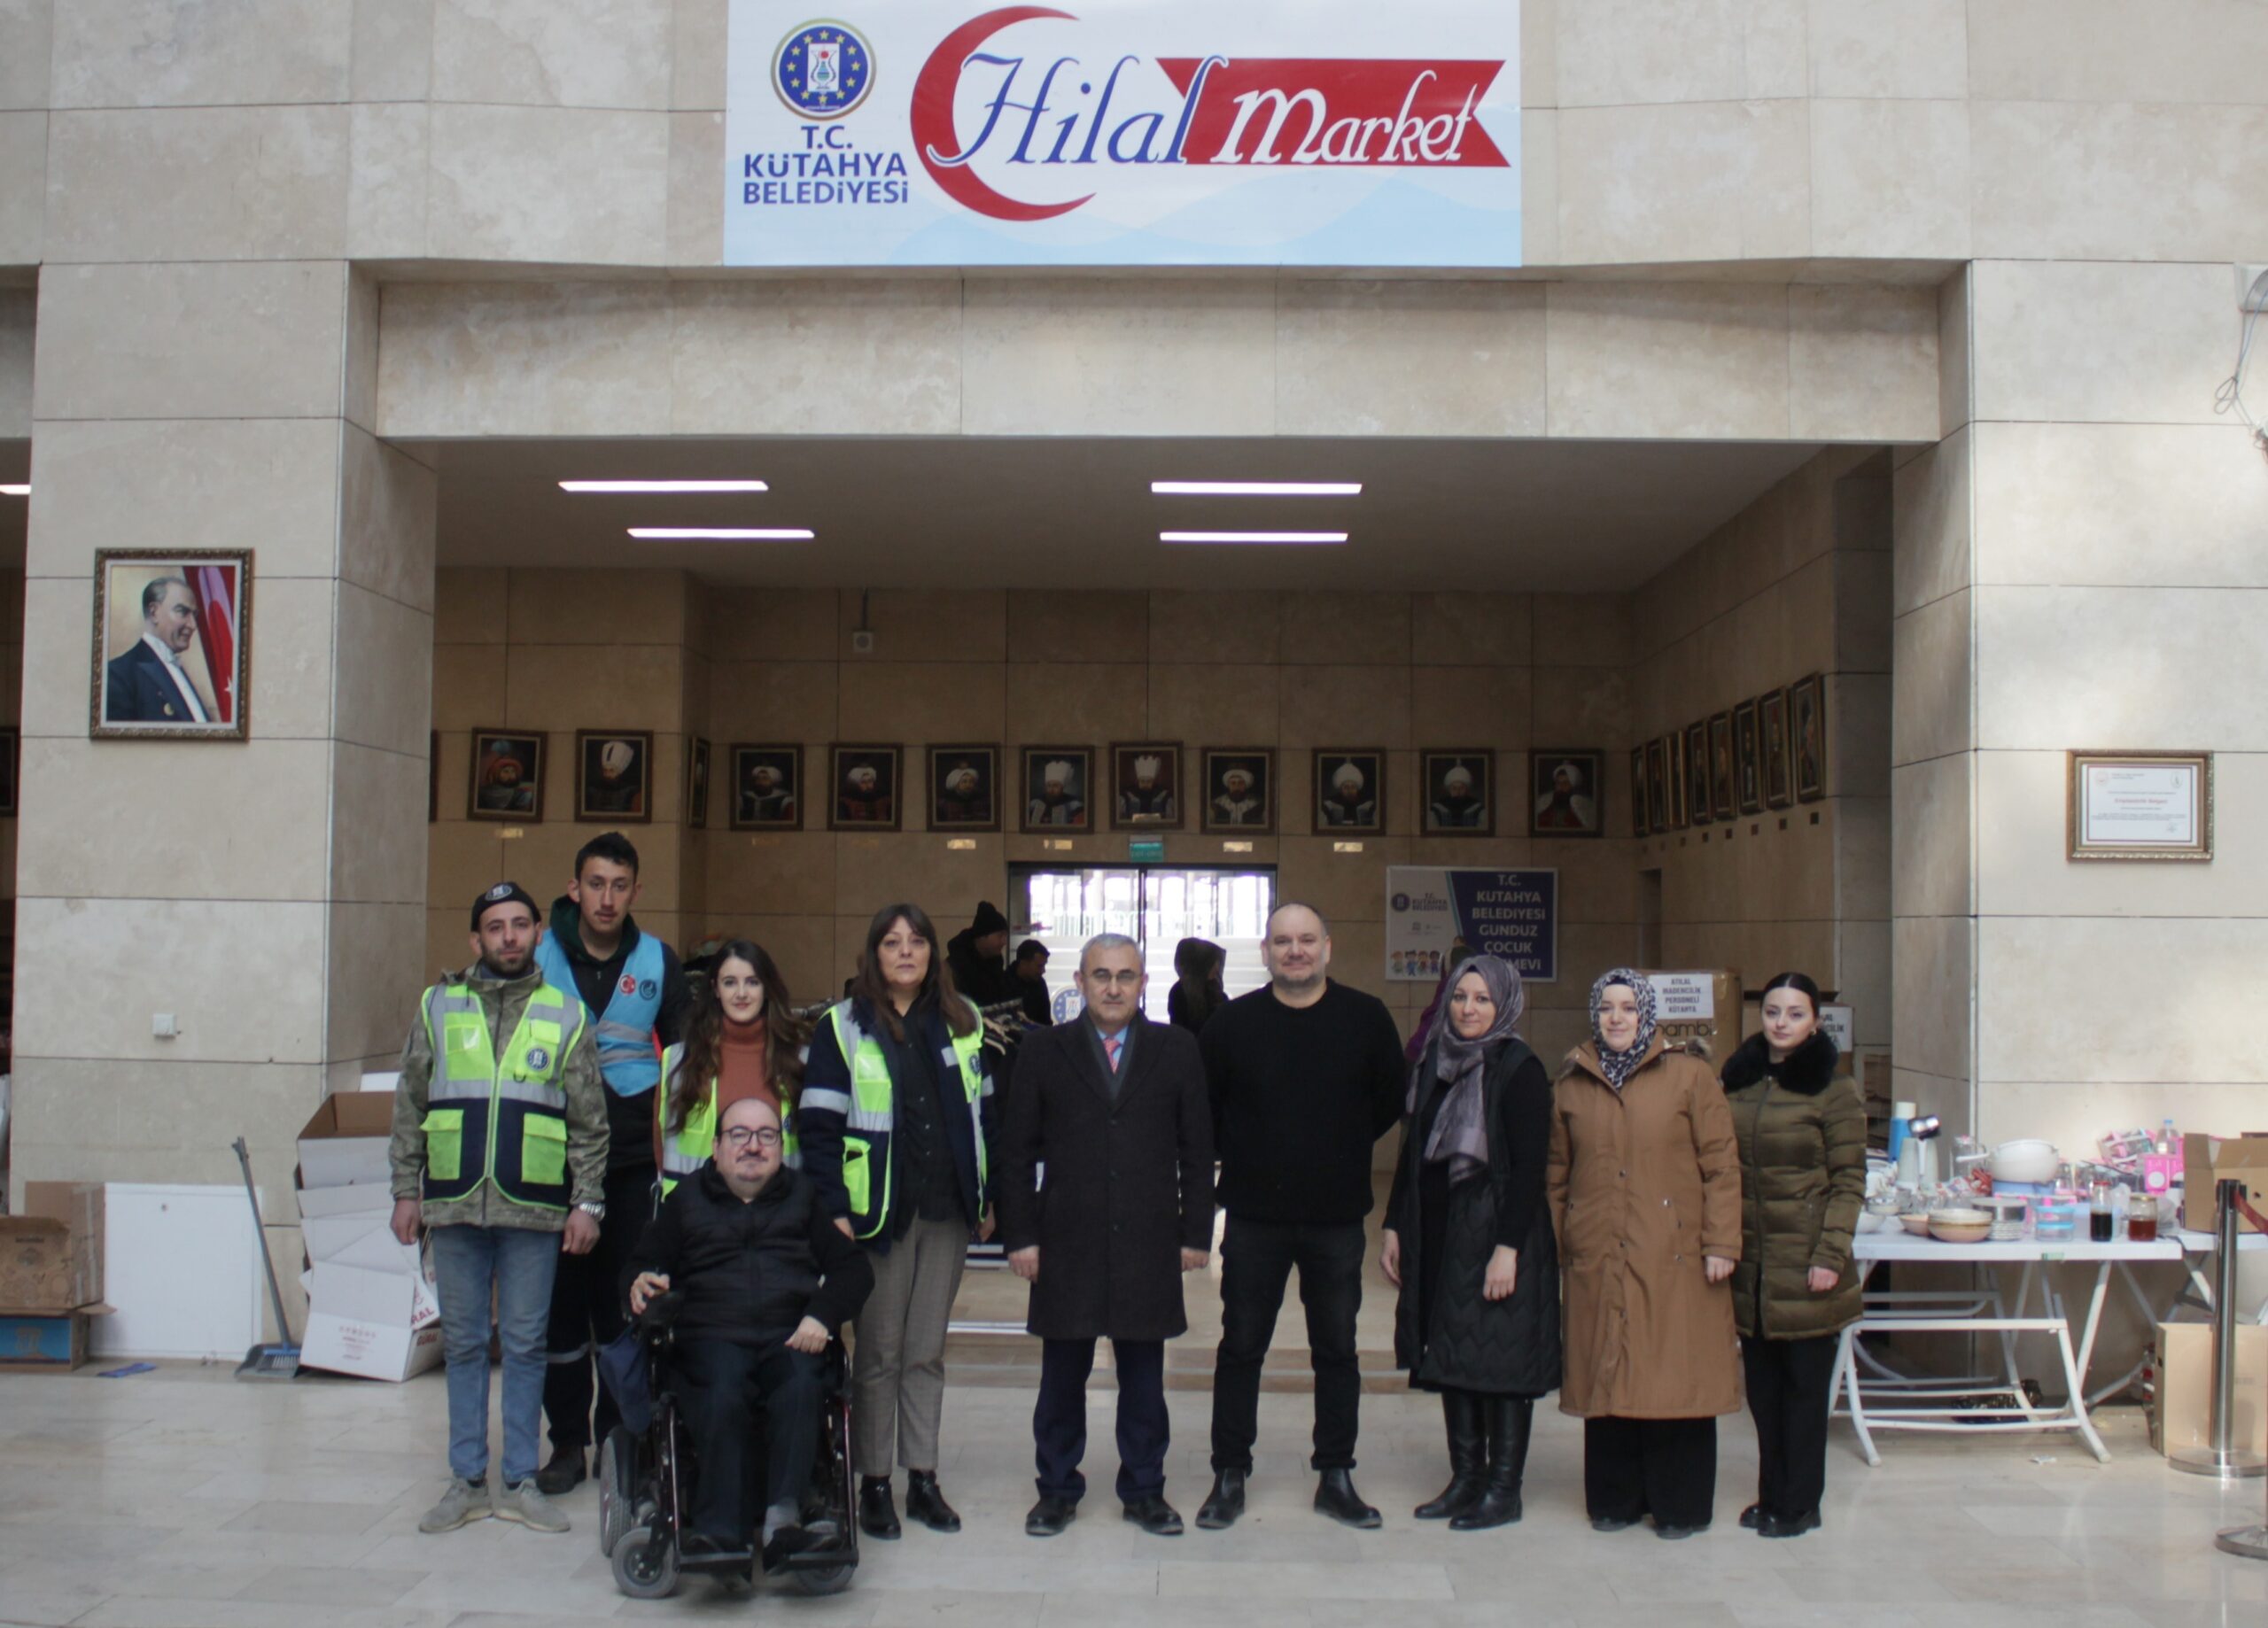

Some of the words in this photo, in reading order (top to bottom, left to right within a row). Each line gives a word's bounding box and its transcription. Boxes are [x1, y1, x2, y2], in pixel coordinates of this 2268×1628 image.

[928, 53, 1228, 167] Hilal
[801, 125, 853, 149] T.C.
[744, 152, 907, 177] KÜTAHYA
[1497, 874, 1522, 886] T.C.
